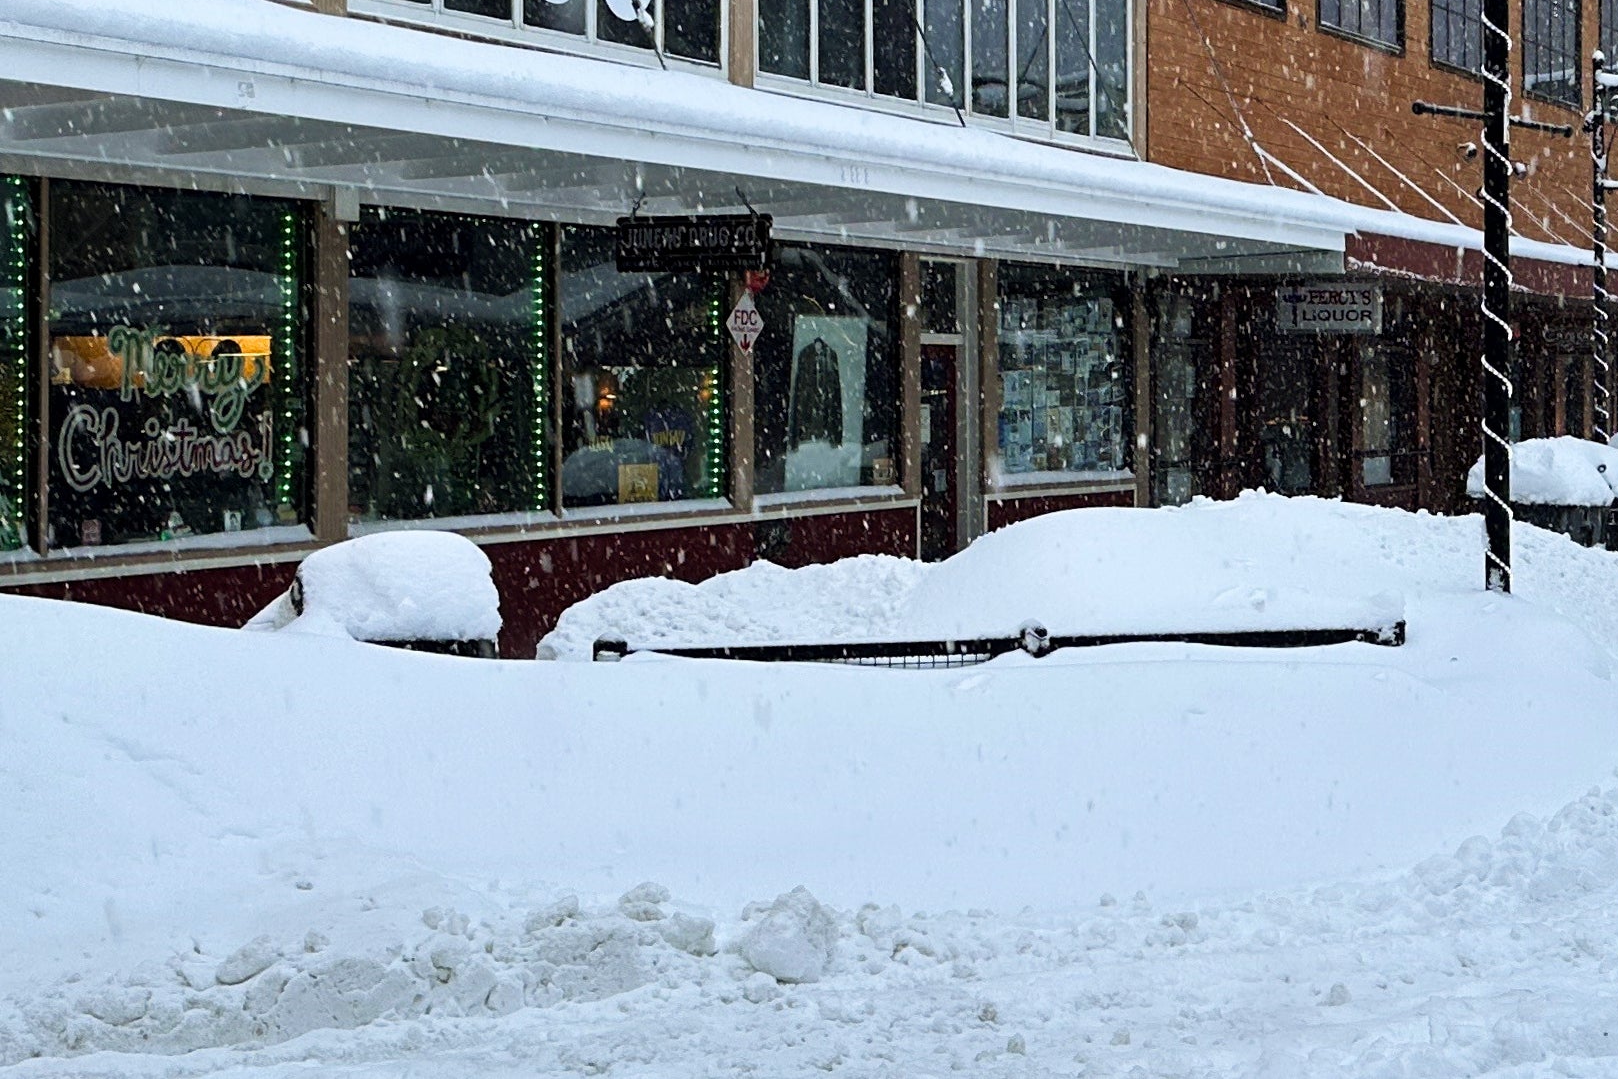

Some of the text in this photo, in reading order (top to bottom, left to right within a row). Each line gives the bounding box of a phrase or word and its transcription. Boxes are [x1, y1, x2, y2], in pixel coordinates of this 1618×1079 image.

[689, 223, 731, 248] DRUG
[734, 309, 757, 326] FDC
[1302, 309, 1373, 322] LIQUOR
[108, 324, 267, 432] Merry
[58, 403, 274, 493] Christmas!
